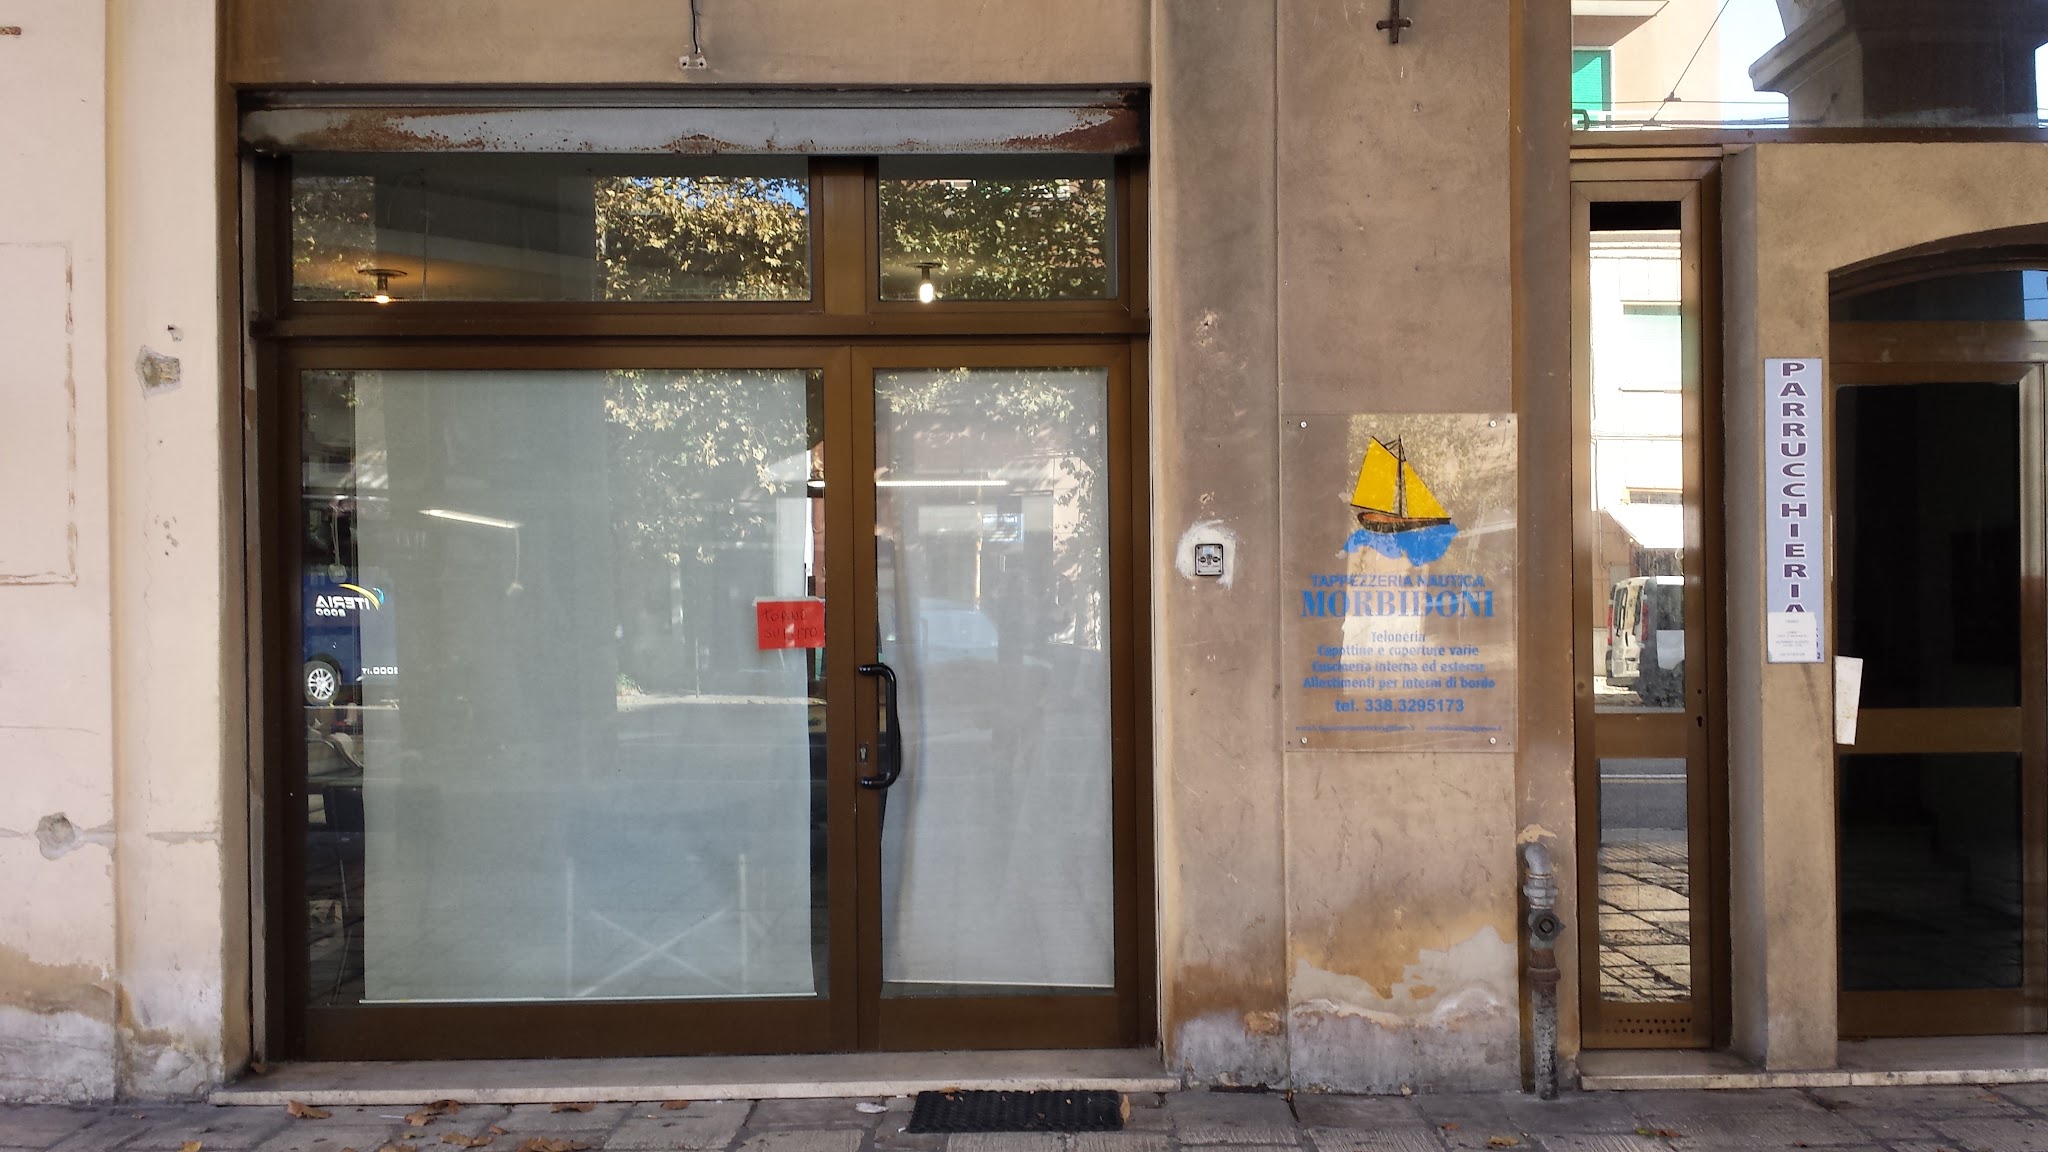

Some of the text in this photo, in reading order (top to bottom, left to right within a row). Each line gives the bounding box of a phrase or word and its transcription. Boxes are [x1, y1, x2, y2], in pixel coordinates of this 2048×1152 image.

[1311, 574, 1486, 588] TAPPEZZERIA NAUTICA
[1301, 590, 1494, 618] MORBIDONI
[1371, 630, 1425, 643] Teloneria
[1317, 644, 1479, 658] Capottine e coperture varie
[1375, 661, 1418, 673] interna
[1422, 660, 1437, 672] ed
[1303, 676, 1495, 691] Allestimenti per interni di bordo
[1334, 698, 1465, 712] tel. 338.3295173
